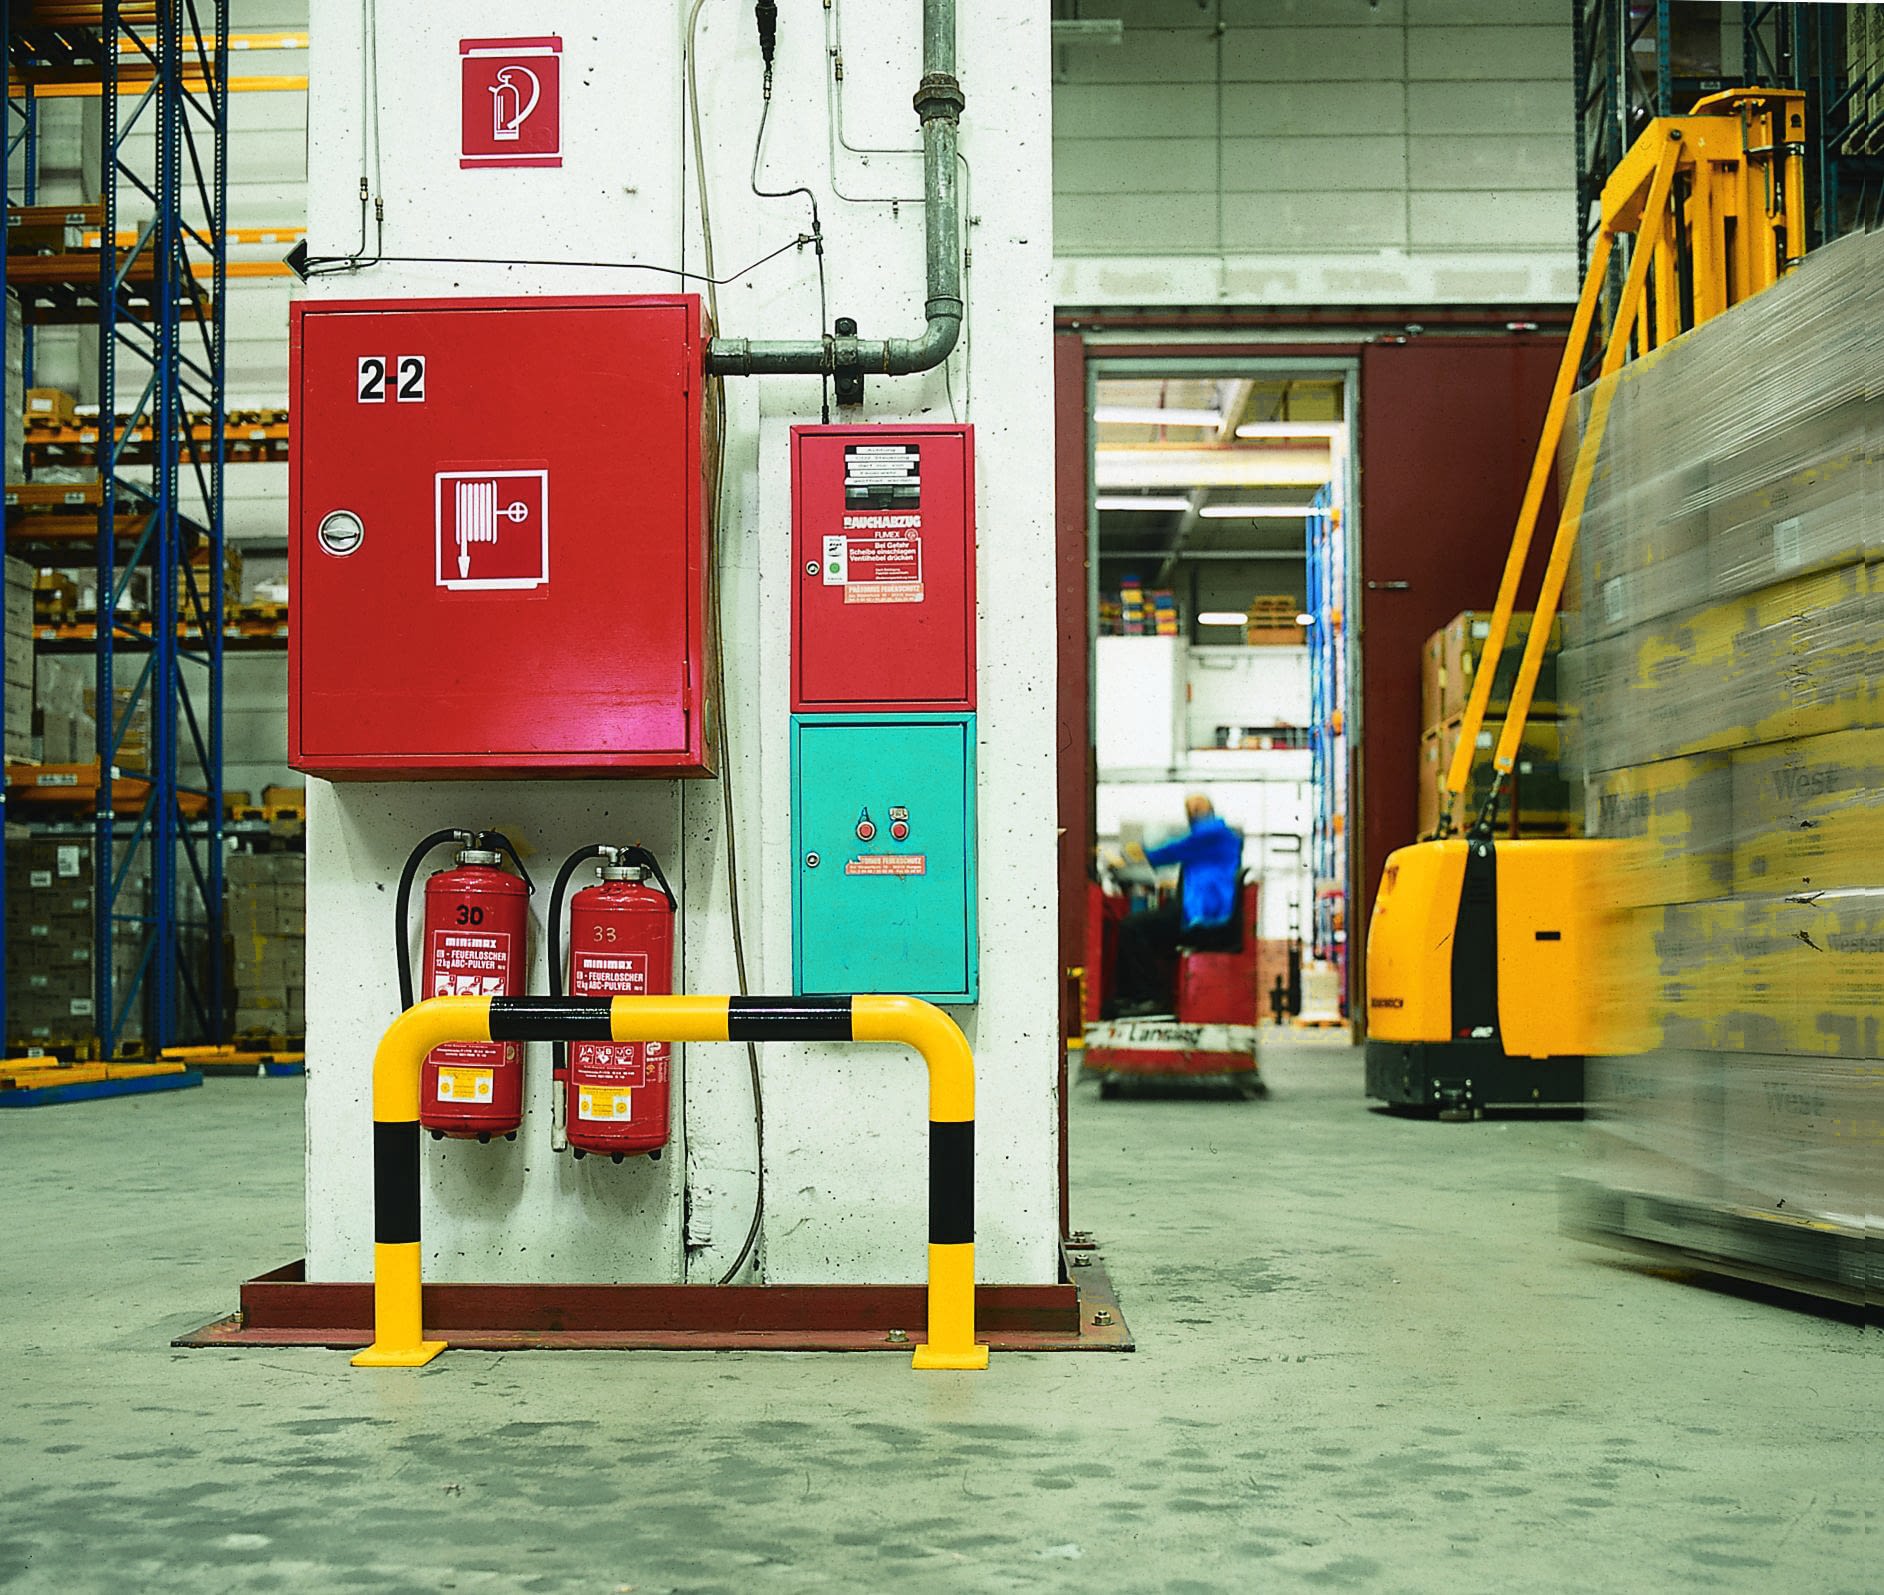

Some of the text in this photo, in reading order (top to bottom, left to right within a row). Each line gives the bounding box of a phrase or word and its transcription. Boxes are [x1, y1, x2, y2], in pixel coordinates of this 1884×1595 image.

[360, 358, 423, 400] 2-2
[874, 531, 900, 539] FUMEX
[887, 542, 909, 550] Gefahr
[877, 548, 916, 556] einschlagen
[456, 904, 483, 925] 30
[593, 925, 617, 943] 33
[445, 937, 497, 949] minimax
[450, 960, 495, 970] ABC-PULVER
[583, 959, 632, 970] minimax
